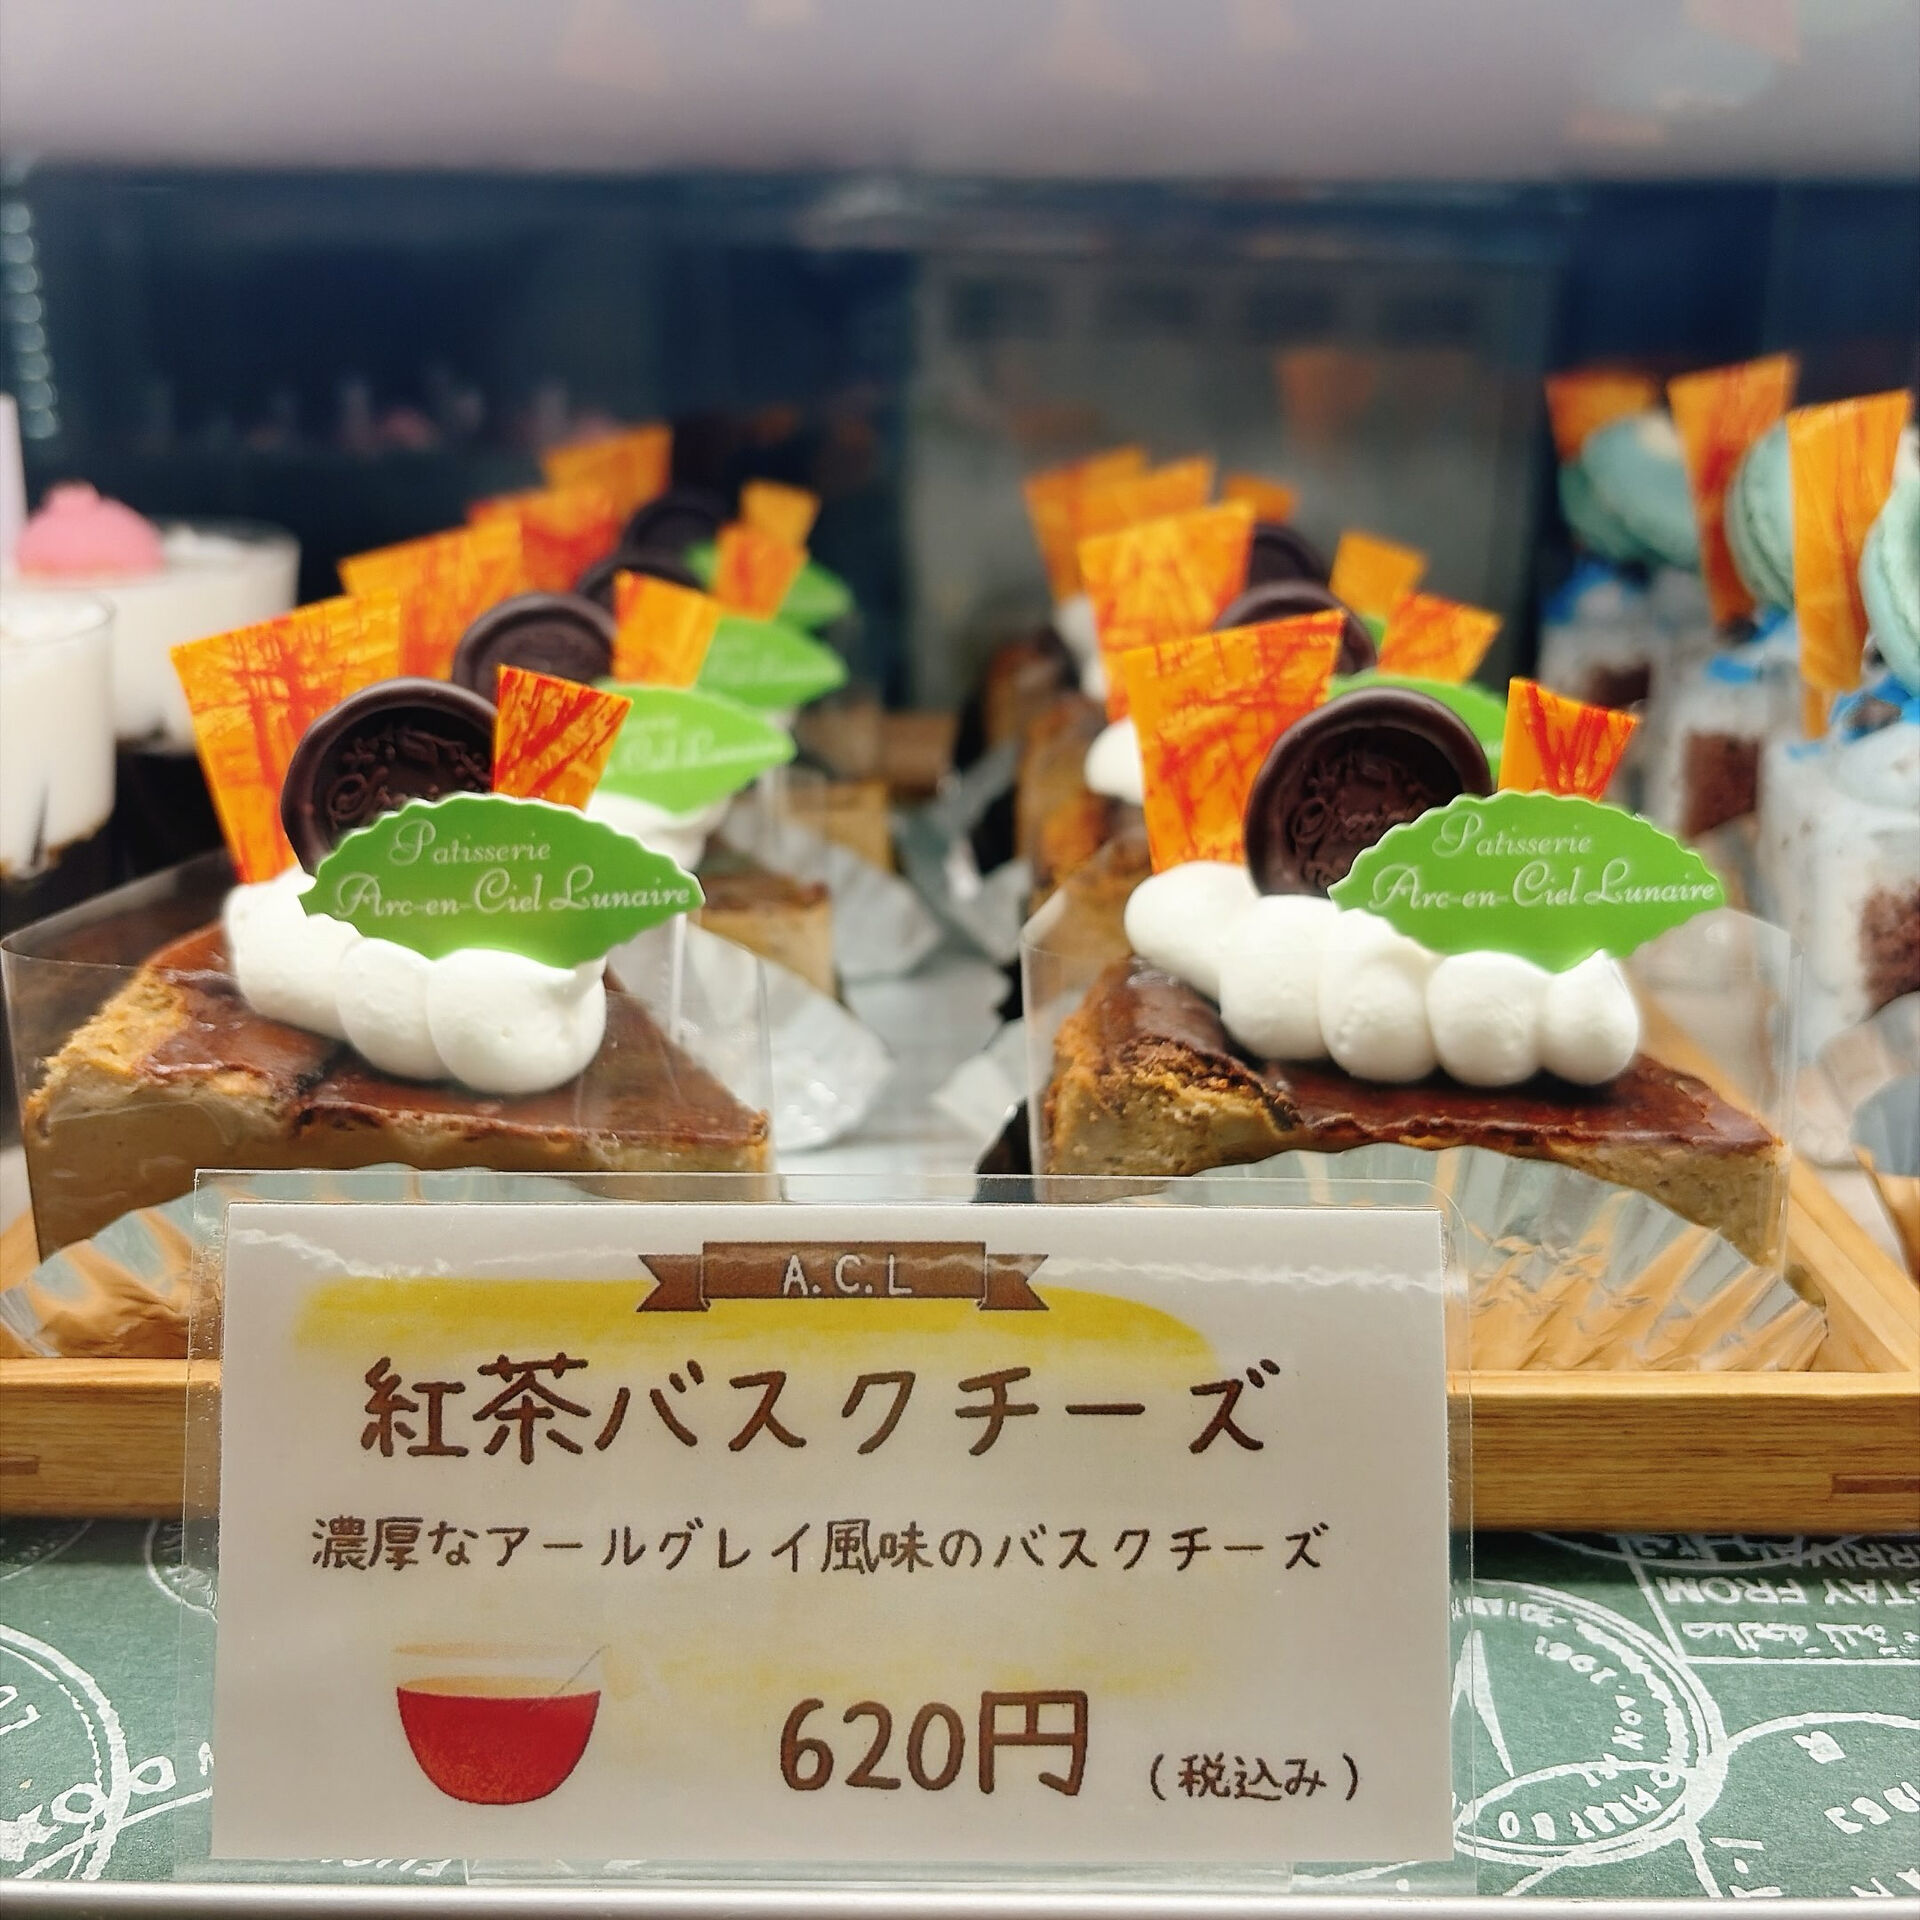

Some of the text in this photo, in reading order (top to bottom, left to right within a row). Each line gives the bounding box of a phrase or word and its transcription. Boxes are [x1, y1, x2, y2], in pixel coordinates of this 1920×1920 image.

[389, 818, 552, 867] Patisserie
[1431, 812, 1593, 857] Patisserie
[550, 863, 691, 912] Lunaire
[1584, 856, 1717, 905] Lunaire
[782, 1253, 913, 1296] A.C.L
[360, 1351, 1281, 1464] 紅茶バスクチーズ
[311, 1514, 1329, 1575] 濃厚なアールグレイ風味のバスクチーズ
[1655, 1576, 1808, 1606] FROM
[780, 1688, 1089, 1797] 620円
